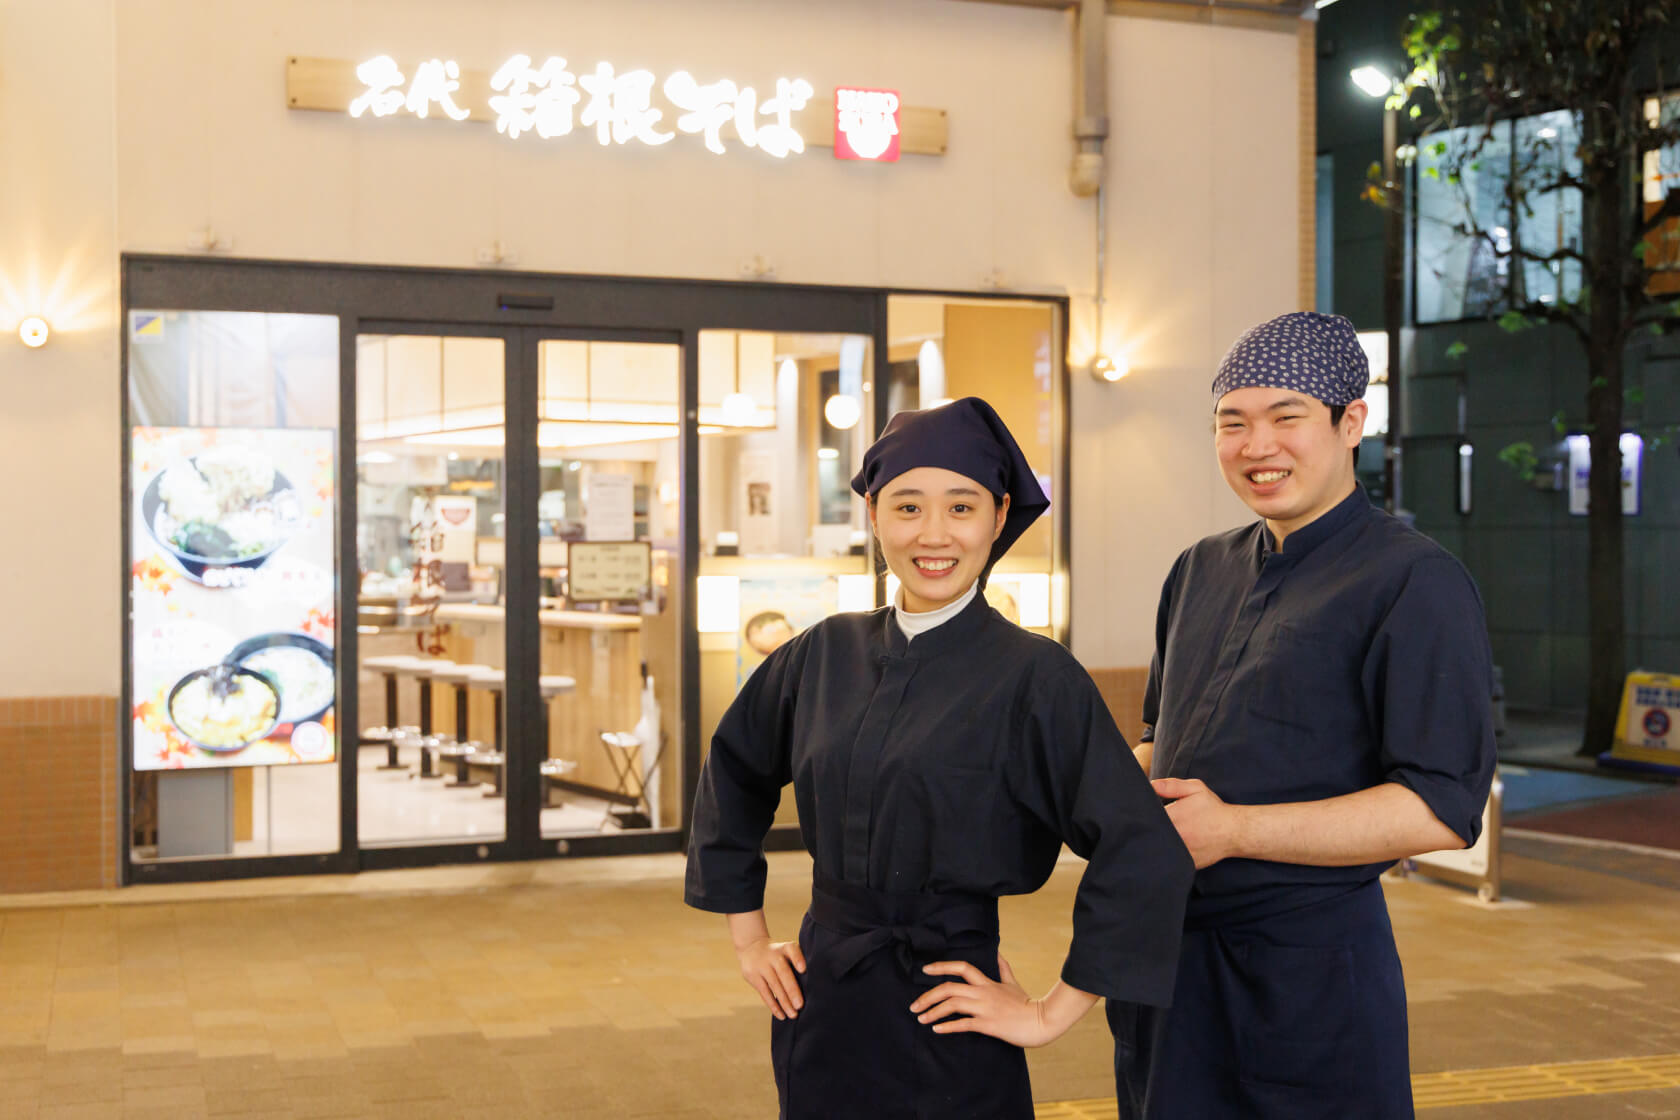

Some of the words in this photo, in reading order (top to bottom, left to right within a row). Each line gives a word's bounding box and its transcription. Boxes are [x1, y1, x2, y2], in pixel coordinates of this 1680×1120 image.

[350, 55, 470, 120] 名代
[488, 54, 814, 157] 箱根そば
